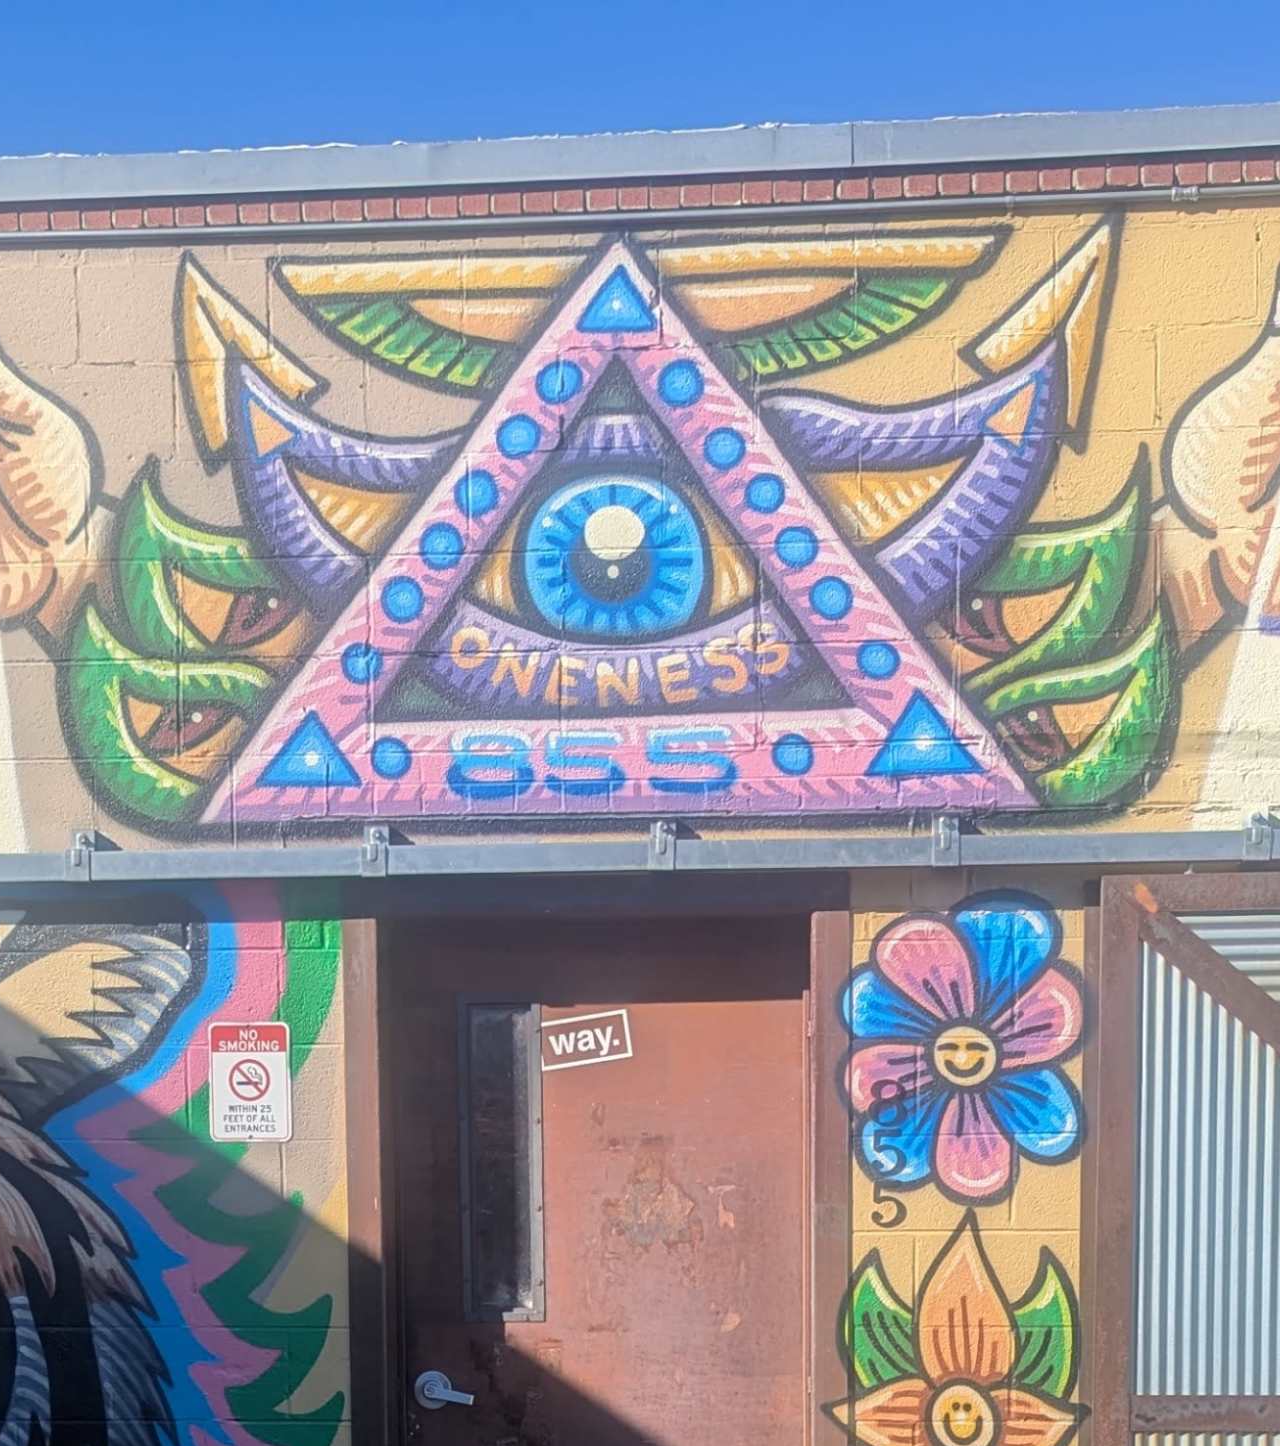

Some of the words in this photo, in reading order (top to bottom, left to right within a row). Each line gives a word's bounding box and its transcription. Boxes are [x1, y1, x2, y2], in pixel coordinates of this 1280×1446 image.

[449, 621, 791, 708] ONENESS
[446, 724, 741, 798] 855
[239, 1029, 258, 1041] NO
[548, 1025, 620, 1056] way.
[218, 1040, 280, 1052] SMOKING
[228, 1104, 258, 1113] WITHIN
[260, 1104, 273, 1112] 25
[223, 1114, 244, 1123] FEET
[246, 1115, 257, 1123] OF
[260, 1115, 276, 1123] ALL
[224, 1124, 276, 1133] ENTRANCES
